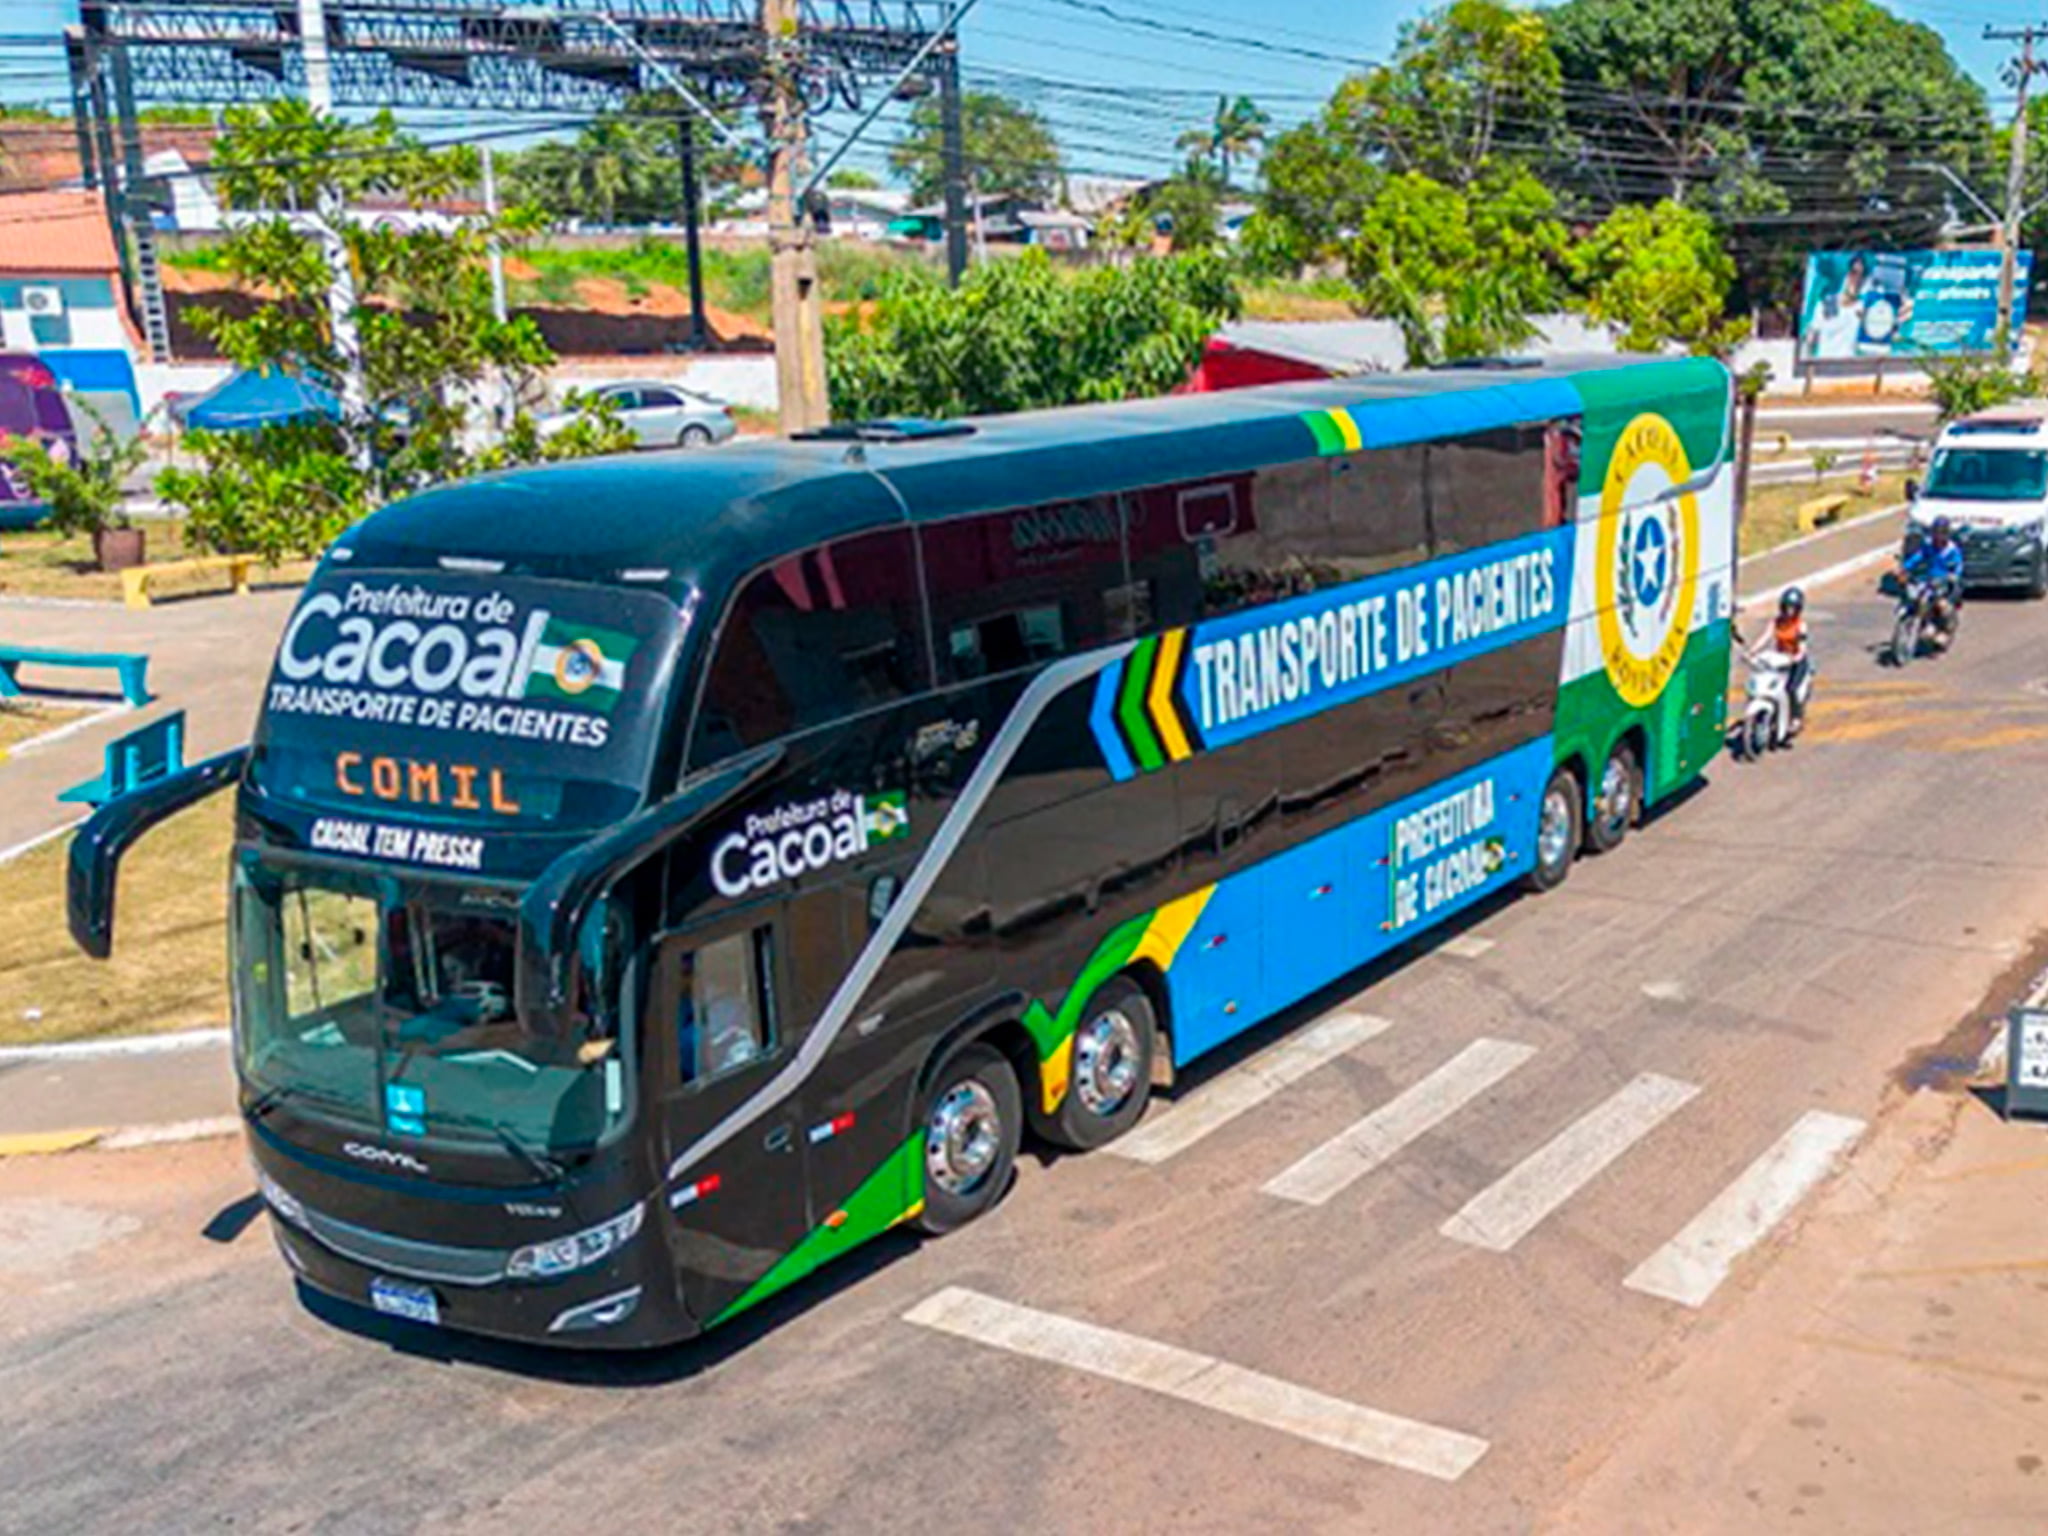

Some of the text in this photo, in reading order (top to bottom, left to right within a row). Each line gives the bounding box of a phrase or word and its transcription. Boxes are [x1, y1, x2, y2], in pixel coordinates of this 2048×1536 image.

[345, 581, 515, 624] Prefeitura de
[279, 592, 551, 700] Cacoal
[1193, 548, 1554, 729] TRANSPORTE DE PACIENTES
[269, 683, 609, 747] TRANSPORTE DE PACIENTES
[335, 751, 521, 815] COMIL
[311, 817, 486, 870] CACOAL TEM PRESSA
[710, 793, 869, 897] Cacoal
